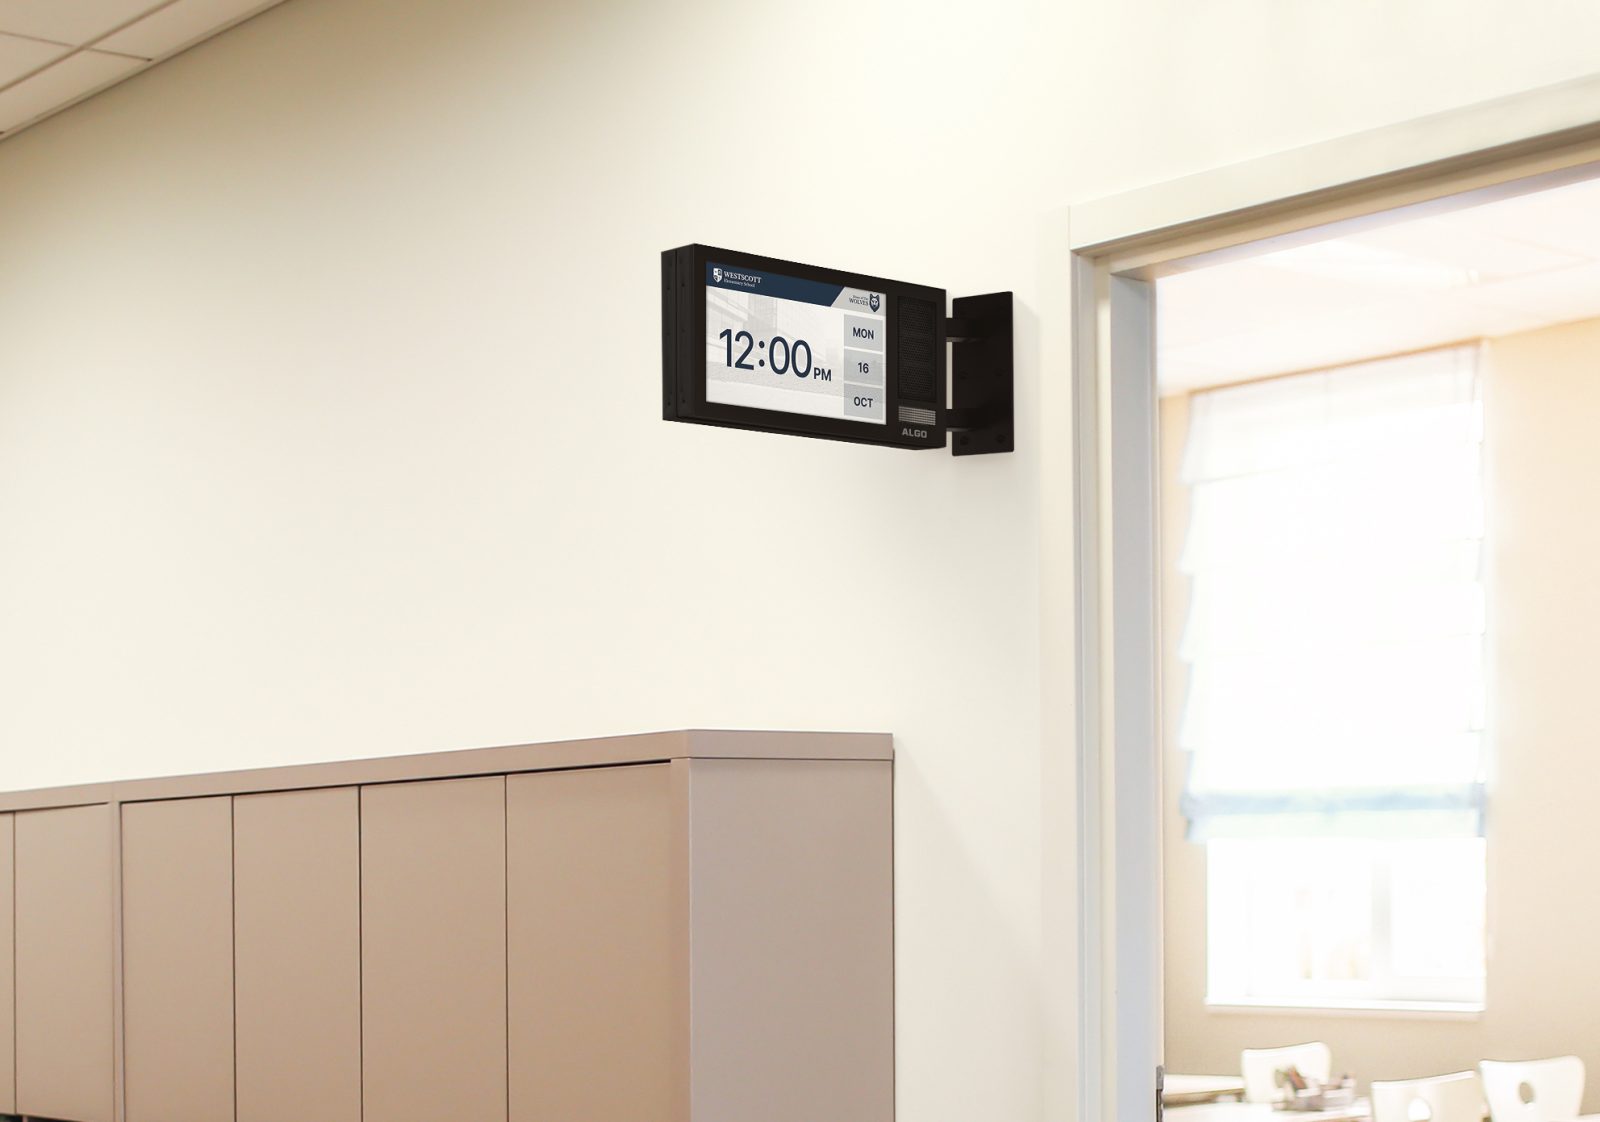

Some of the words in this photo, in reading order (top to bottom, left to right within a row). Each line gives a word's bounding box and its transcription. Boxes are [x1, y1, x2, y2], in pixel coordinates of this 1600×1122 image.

[724, 271, 762, 283] WESTSCOTT
[849, 298, 868, 306] WOLVES
[853, 327, 874, 339] MON
[720, 329, 812, 378] 12:00
[814, 367, 832, 381] PM
[858, 362, 869, 374] 16
[854, 397, 873, 408] OCT
[902, 428, 928, 438] ALGO
